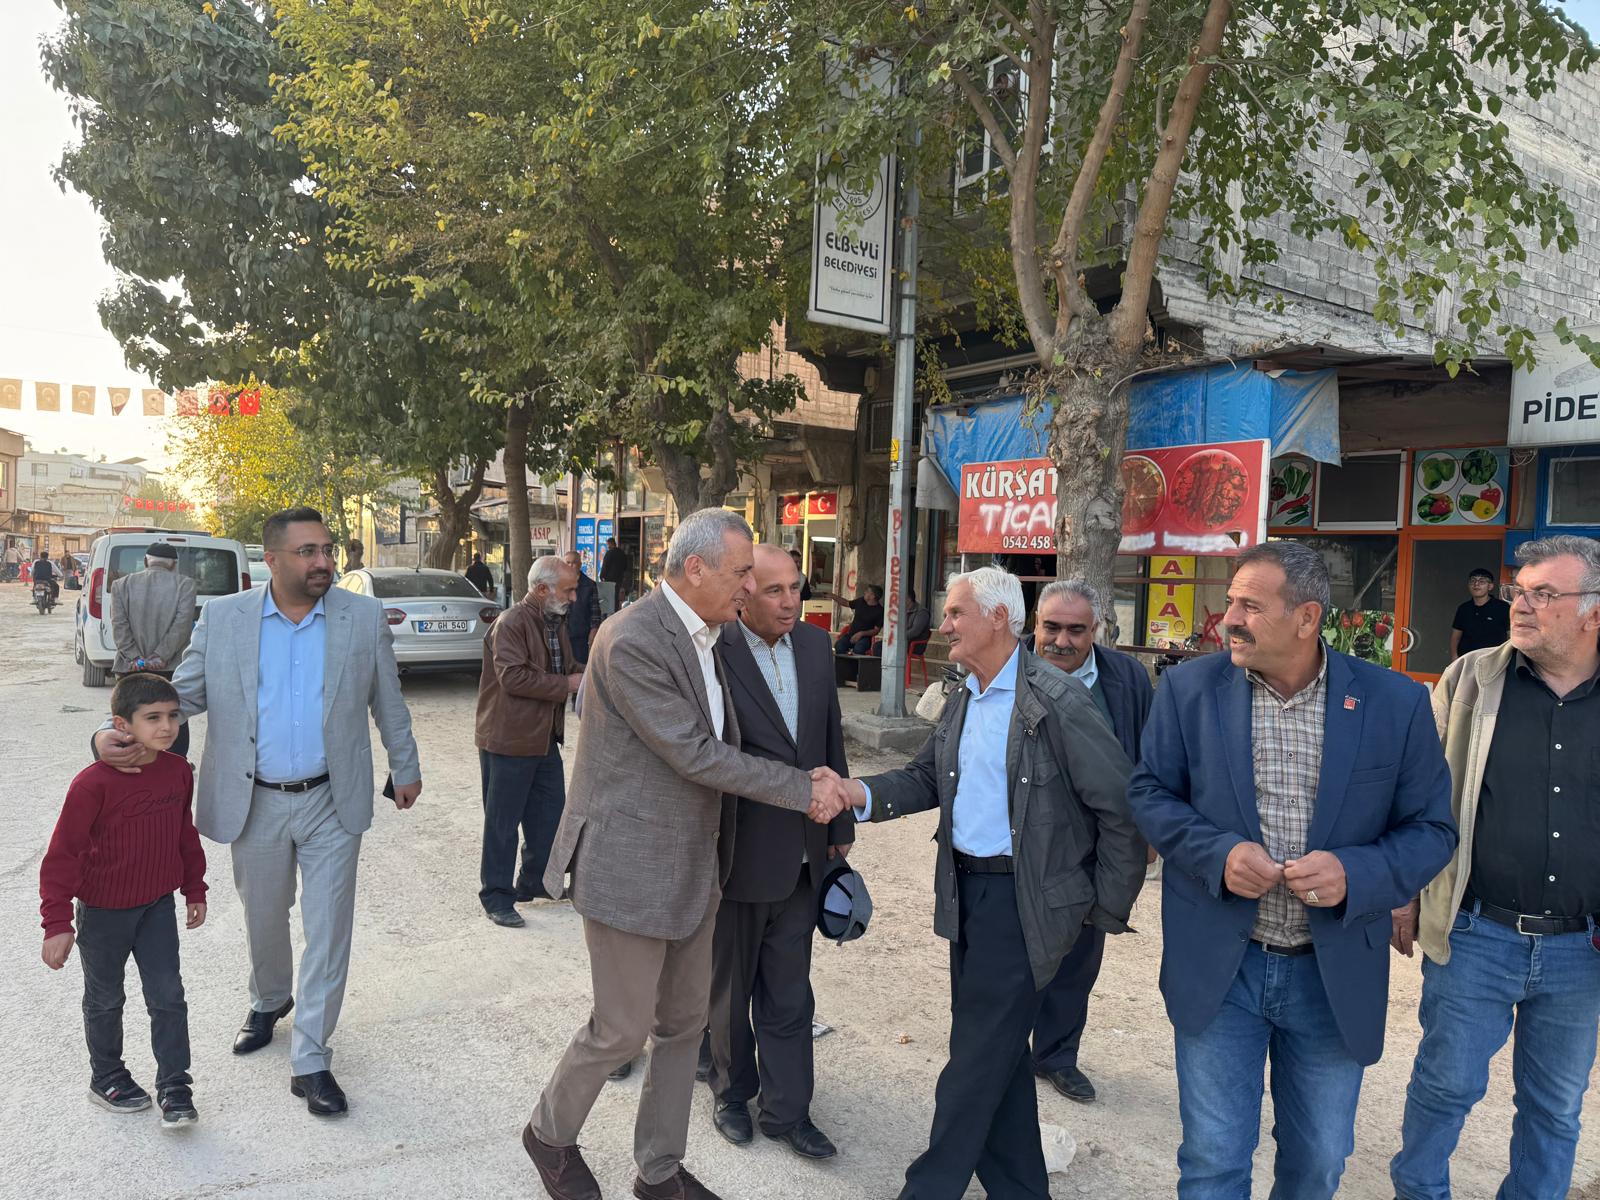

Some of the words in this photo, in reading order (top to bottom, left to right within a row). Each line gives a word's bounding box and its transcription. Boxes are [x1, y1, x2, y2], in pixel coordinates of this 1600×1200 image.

[824, 256, 877, 279] BELEDİYESİ
[1002, 535, 1028, 549] 0542
[1030, 535, 1051, 549] 458
